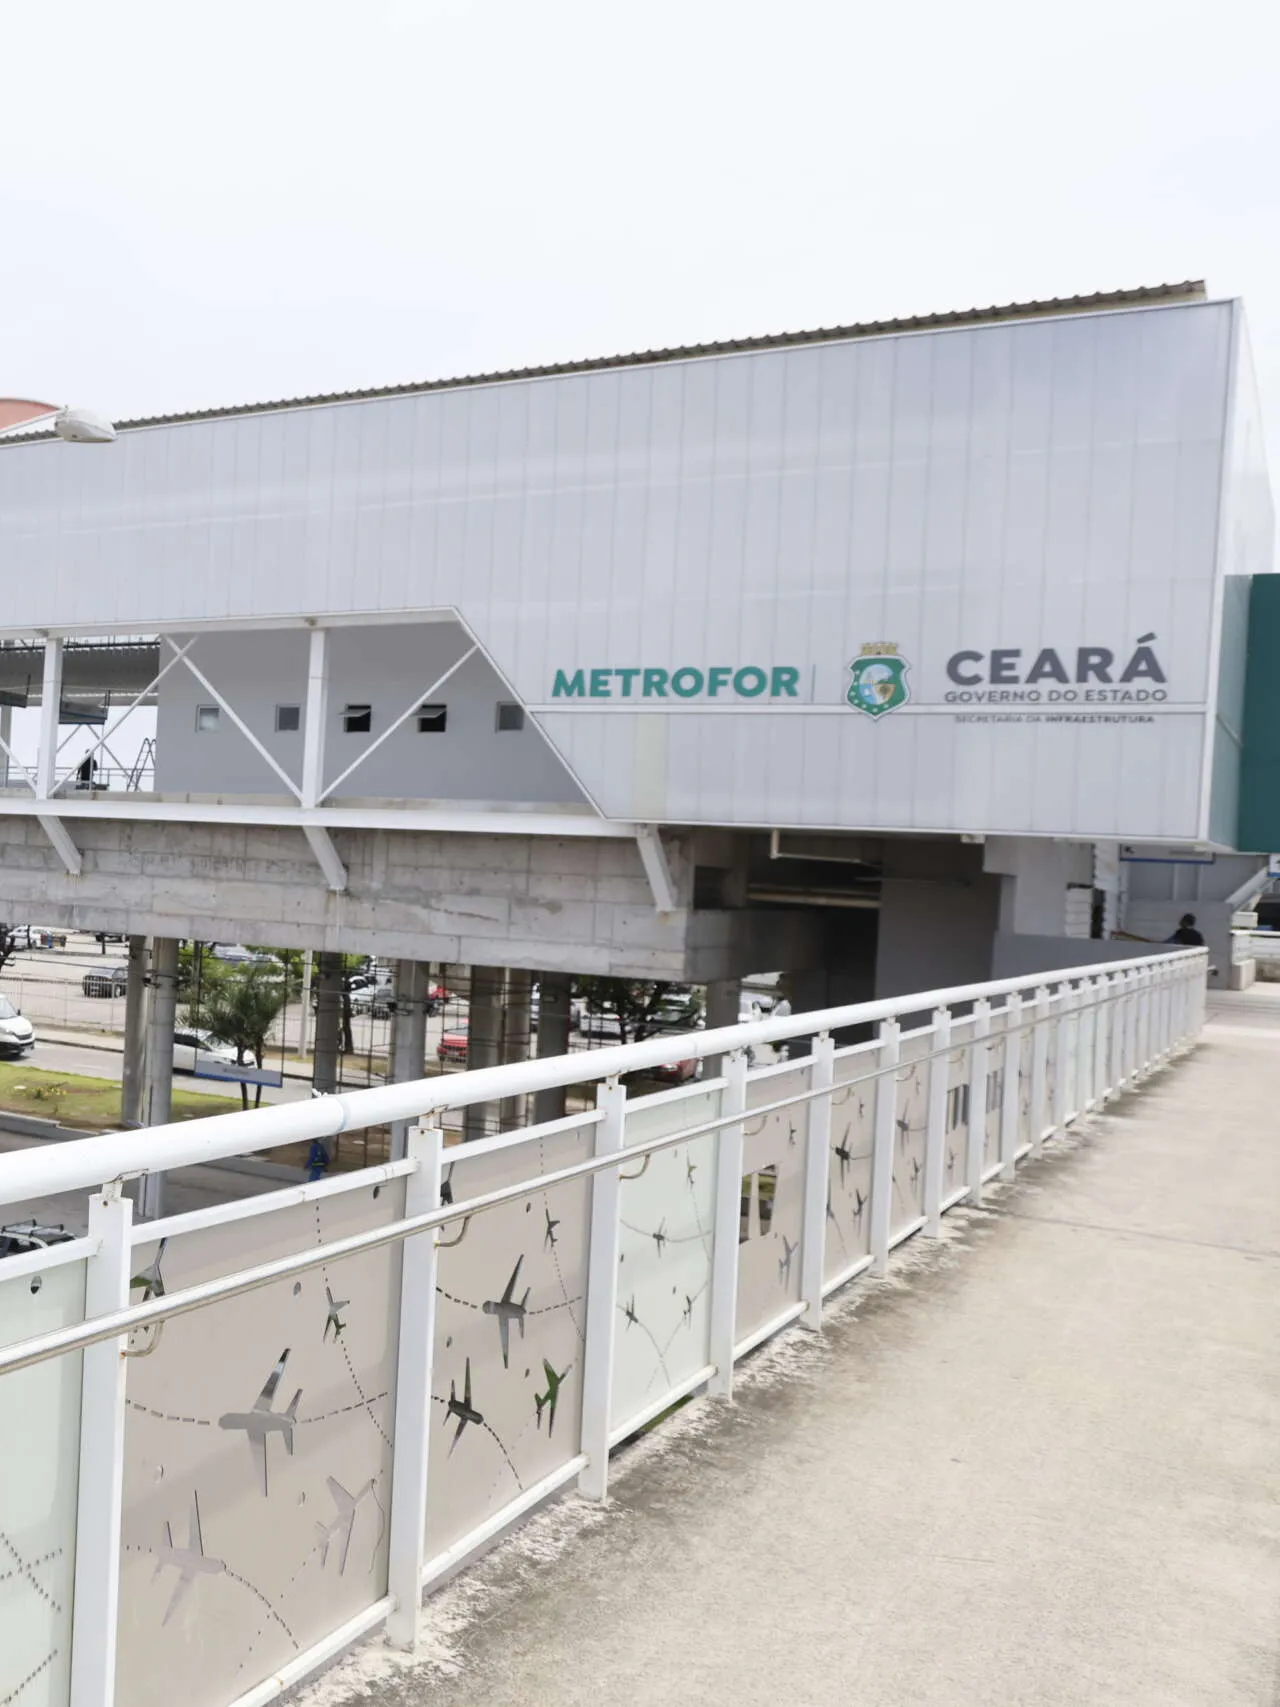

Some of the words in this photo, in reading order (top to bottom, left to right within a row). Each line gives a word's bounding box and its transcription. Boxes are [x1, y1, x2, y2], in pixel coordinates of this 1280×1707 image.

[946, 632, 1167, 686] CEARÁ
[551, 666, 800, 698] METROFOR
[944, 689, 1042, 703] GOVERNO
[1048, 689, 1078, 702] DO
[1084, 688, 1168, 702] ESTADO
[953, 715, 1022, 724] SECRETARIA
[1025, 715, 1042, 724] DA
[1045, 715, 1155, 724] INFRAESTRUTURA
